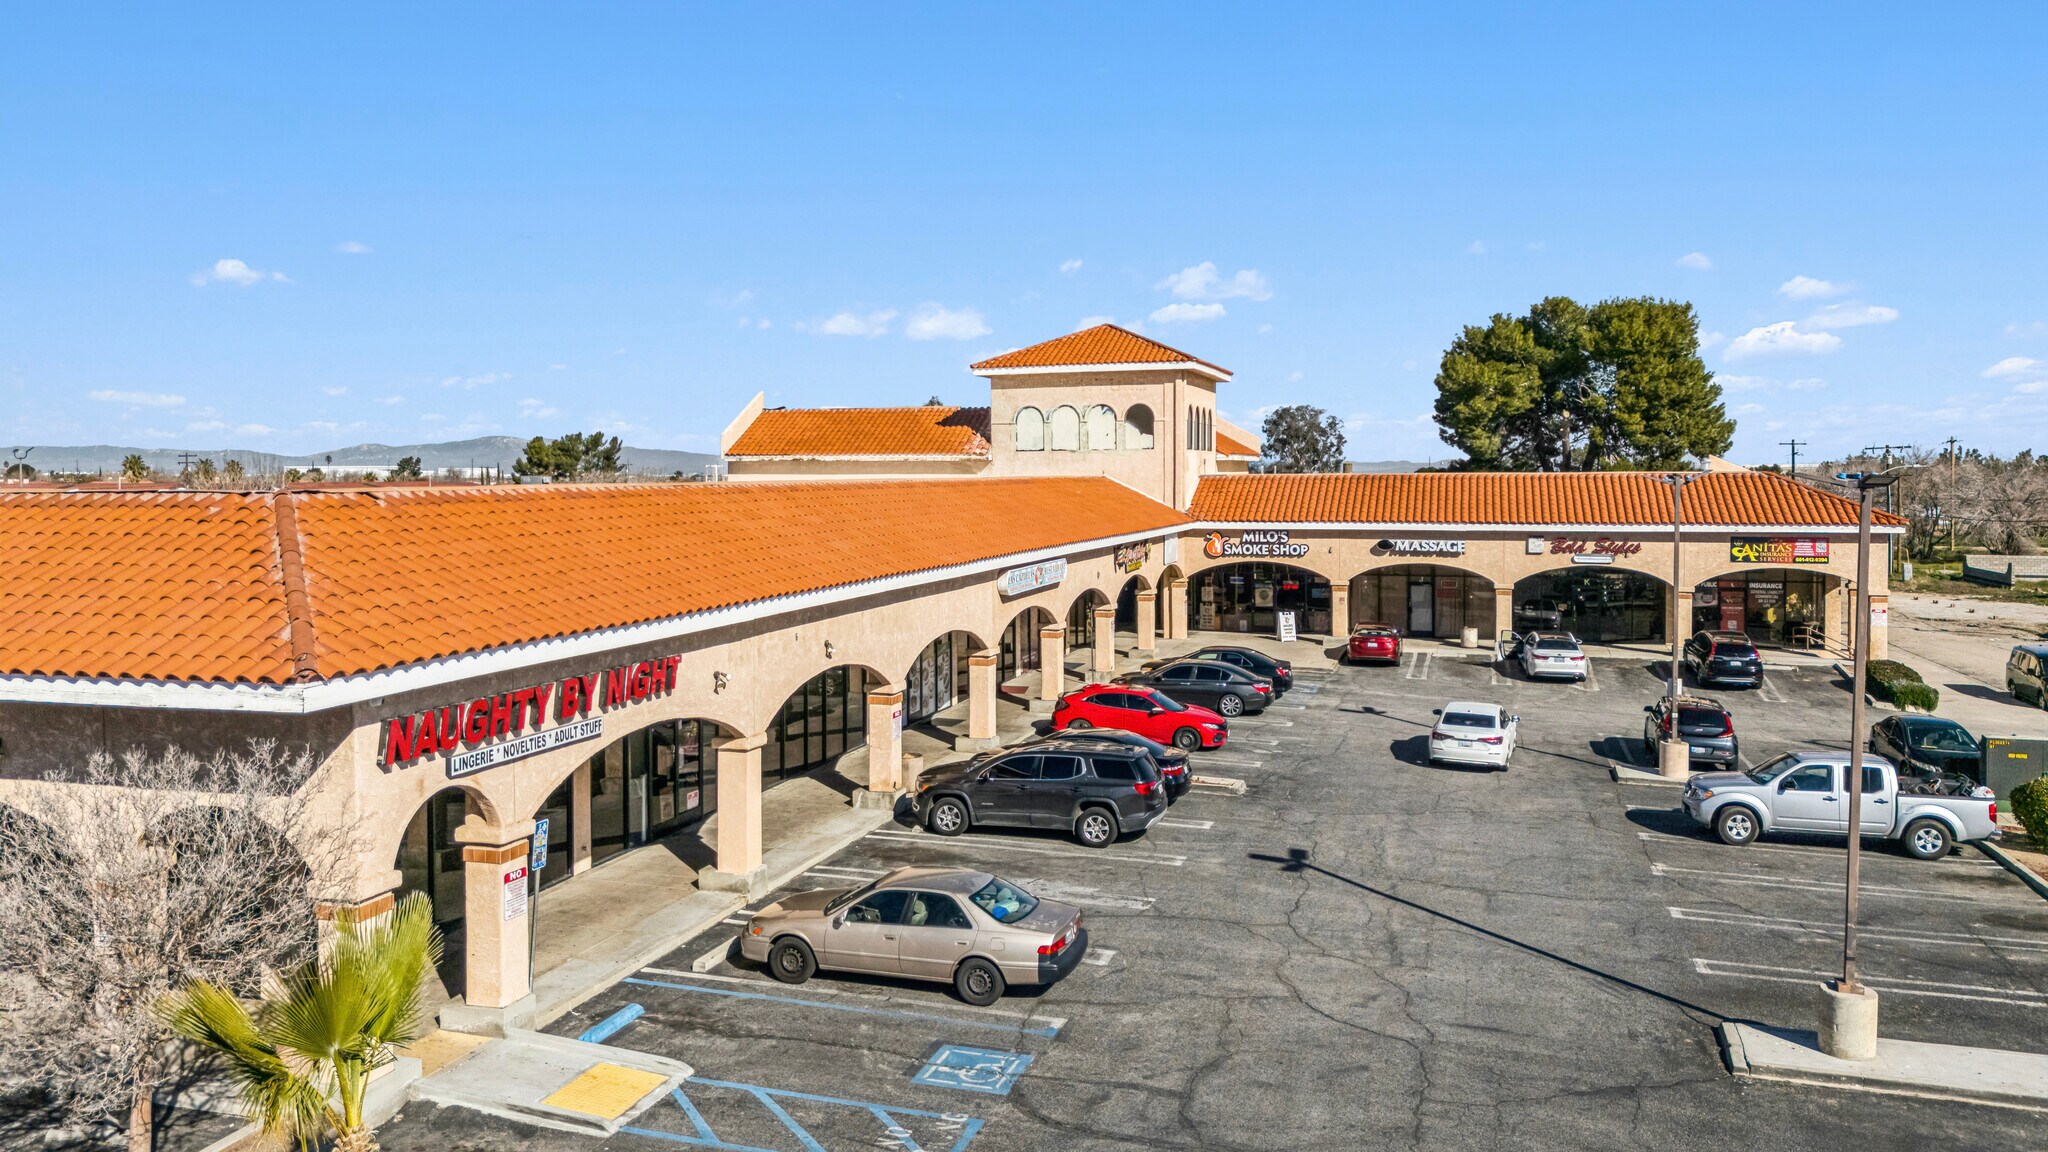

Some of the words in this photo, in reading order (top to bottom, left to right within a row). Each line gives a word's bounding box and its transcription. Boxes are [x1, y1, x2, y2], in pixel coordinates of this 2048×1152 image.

[1242, 531, 1288, 543] MILO'S
[1224, 544, 1269, 555] SMOKE
[1272, 544, 1308, 555] SHOP
[1395, 540, 1465, 552] MASSAGE
[1550, 537, 1587, 555] Bold
[1591, 538, 1642, 558] Styles
[385, 683, 554, 766] NAUGHTY
[560, 672, 600, 719] BY
[606, 655, 683, 707] NIGHT
[453, 747, 494, 773] LINGERIE
[503, 733, 547, 758] NOVELTIES
[554, 725, 579, 744] ADULT
[580, 719, 602, 738] STUFF
[509, 869, 523, 881] NO
